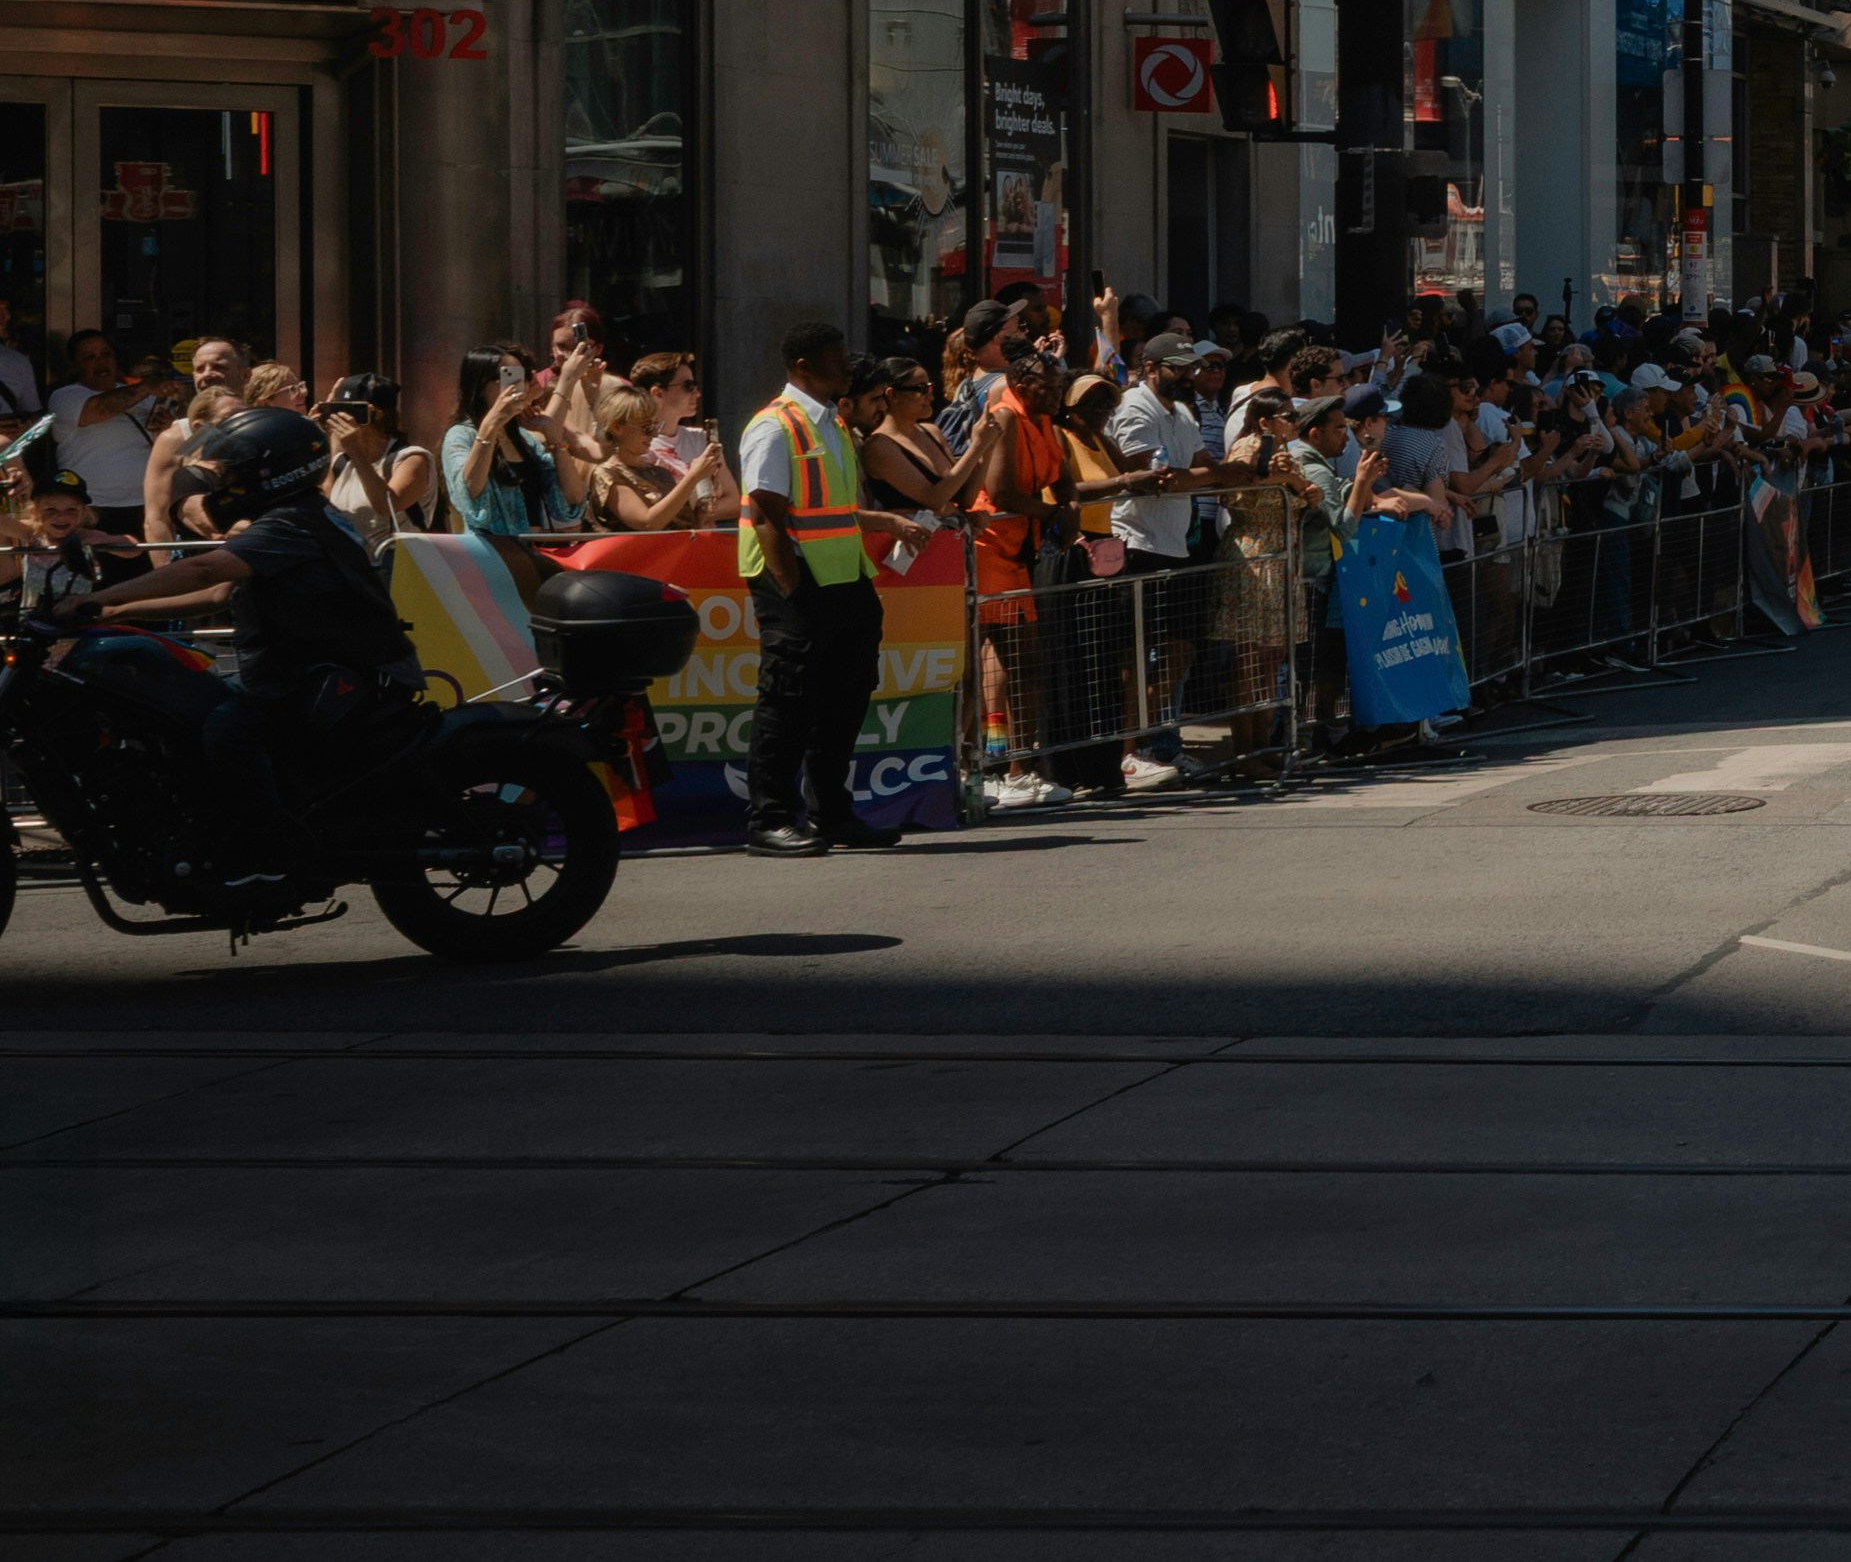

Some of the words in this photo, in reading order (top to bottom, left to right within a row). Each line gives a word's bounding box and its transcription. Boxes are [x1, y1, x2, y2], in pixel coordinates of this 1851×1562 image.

[367, 7, 488, 61] 302
[995, 81, 1022, 109] Bright
[1023, 84, 1045, 111] days,
[995, 109, 1030, 136] brighter
[1031, 113, 1056, 136] deals.
[869, 141, 913, 166] SUMMER
[913, 142, 939, 167] SALE
[667, 648, 956, 698] INCIVE
